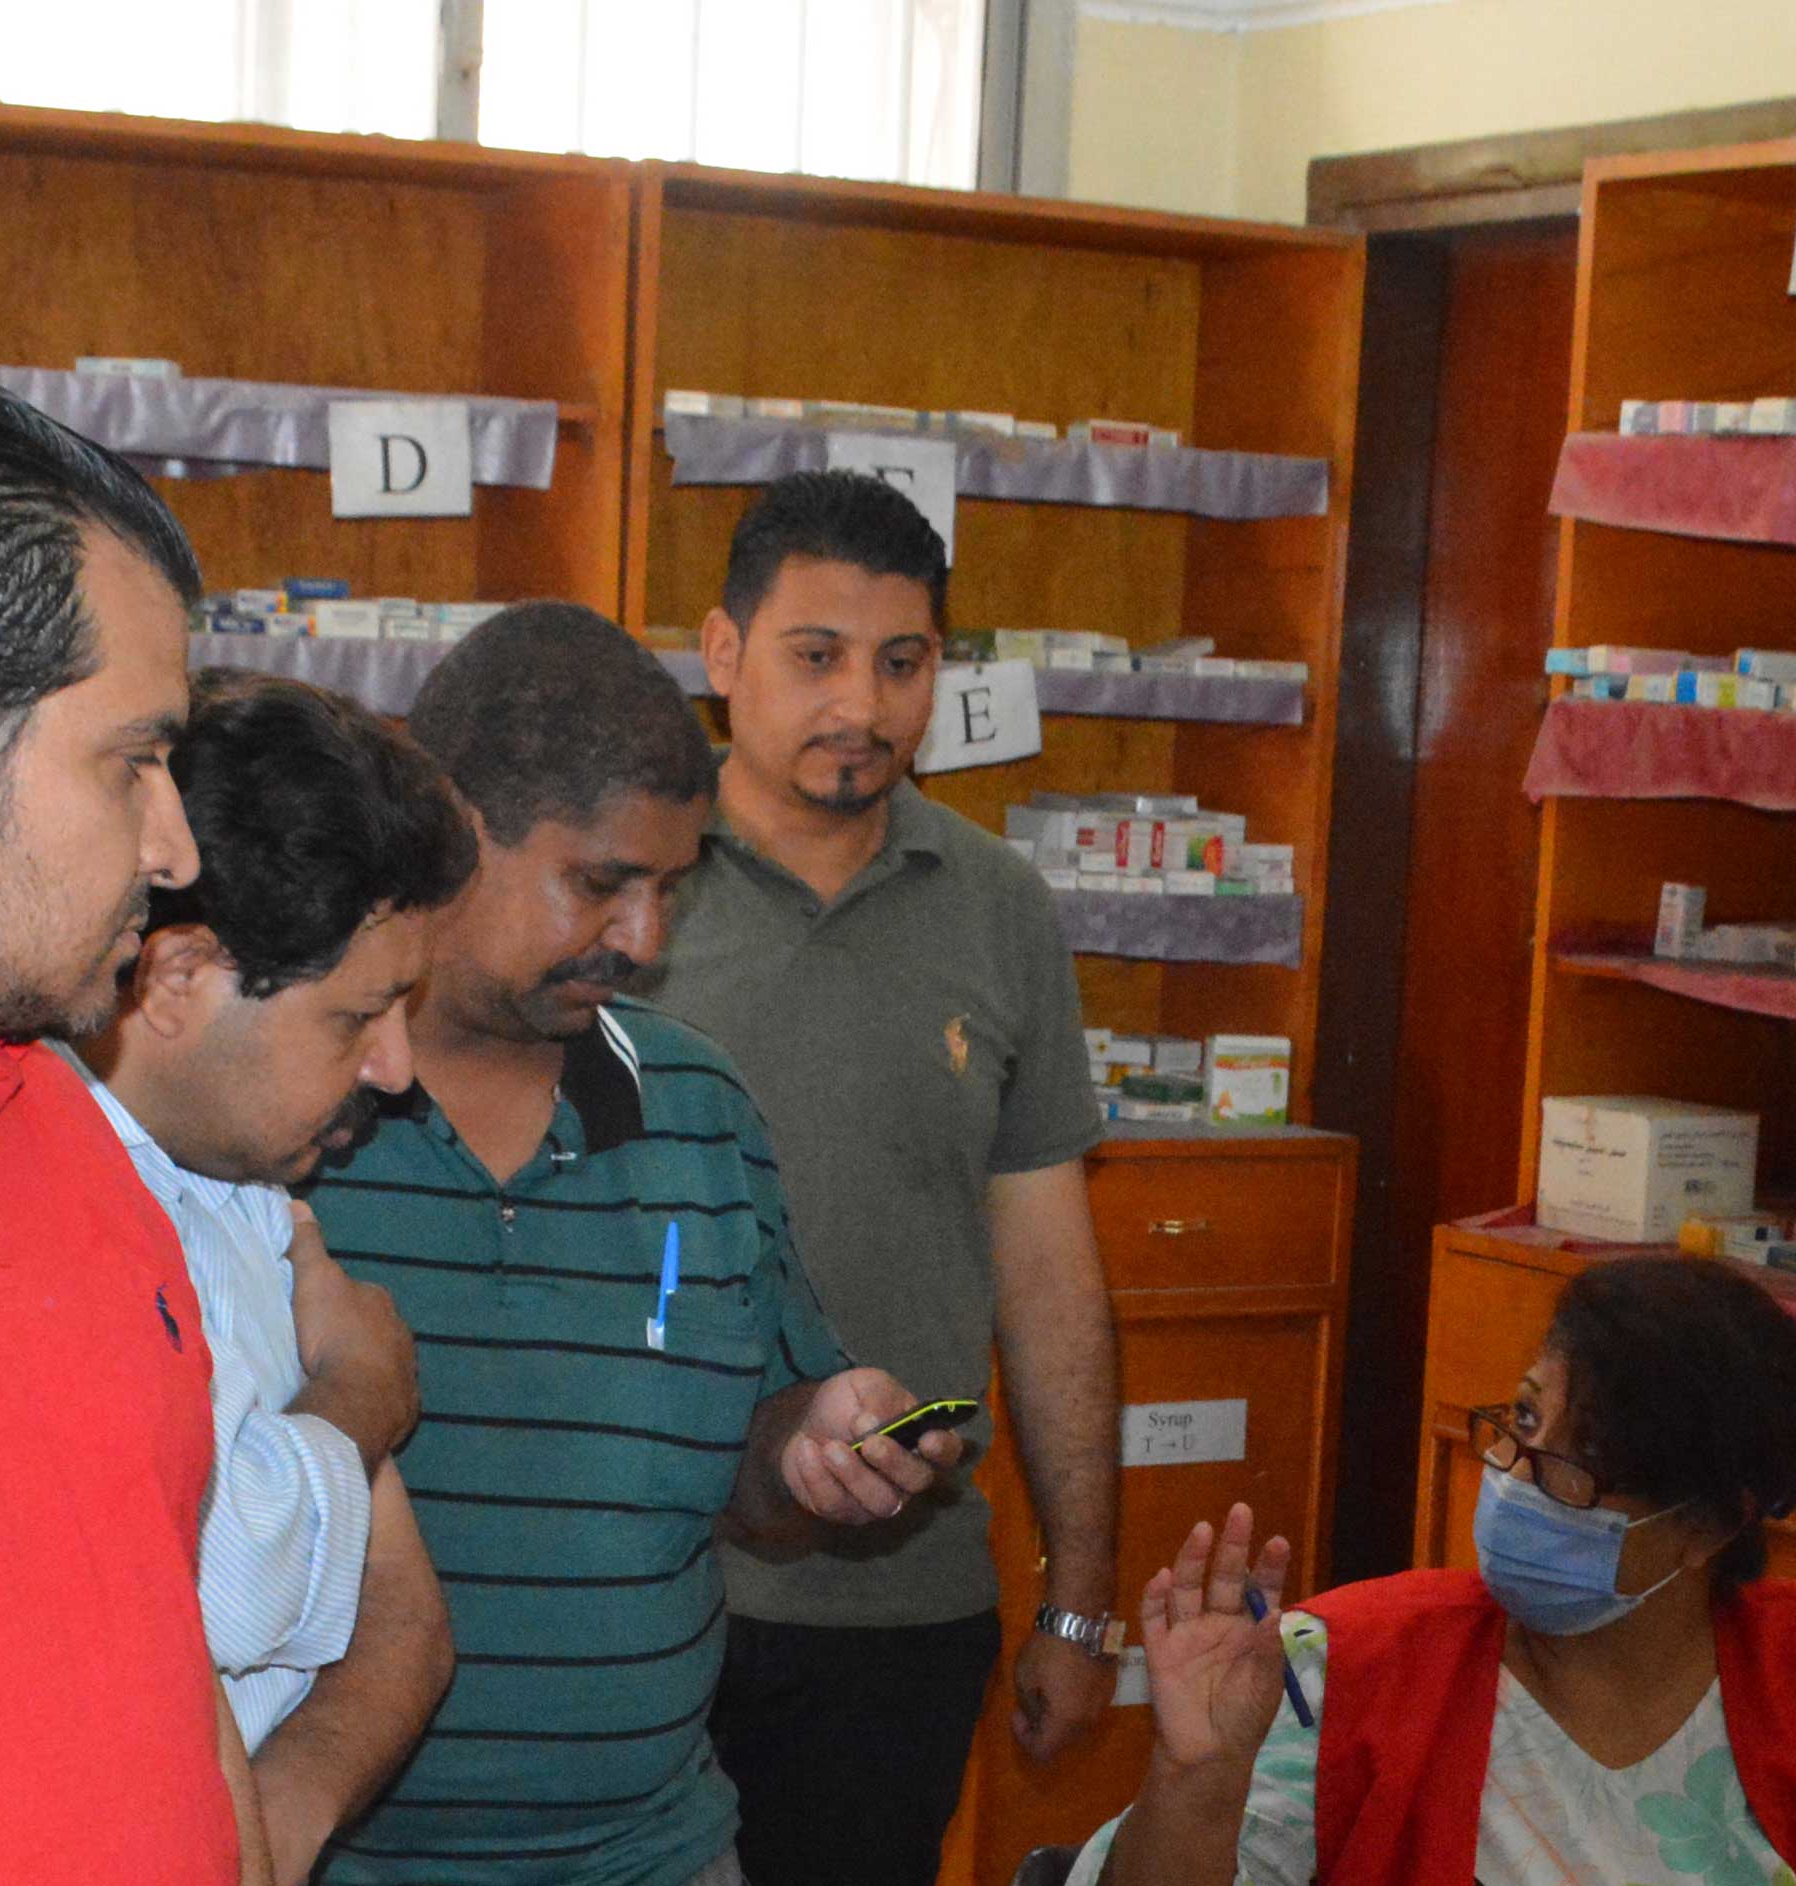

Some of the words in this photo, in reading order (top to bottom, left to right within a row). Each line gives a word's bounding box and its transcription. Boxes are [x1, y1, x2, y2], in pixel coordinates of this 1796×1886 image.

[375, 434, 427, 494] D
[957, 687, 997, 744] E
[1148, 1411, 1193, 1432] Syrup
